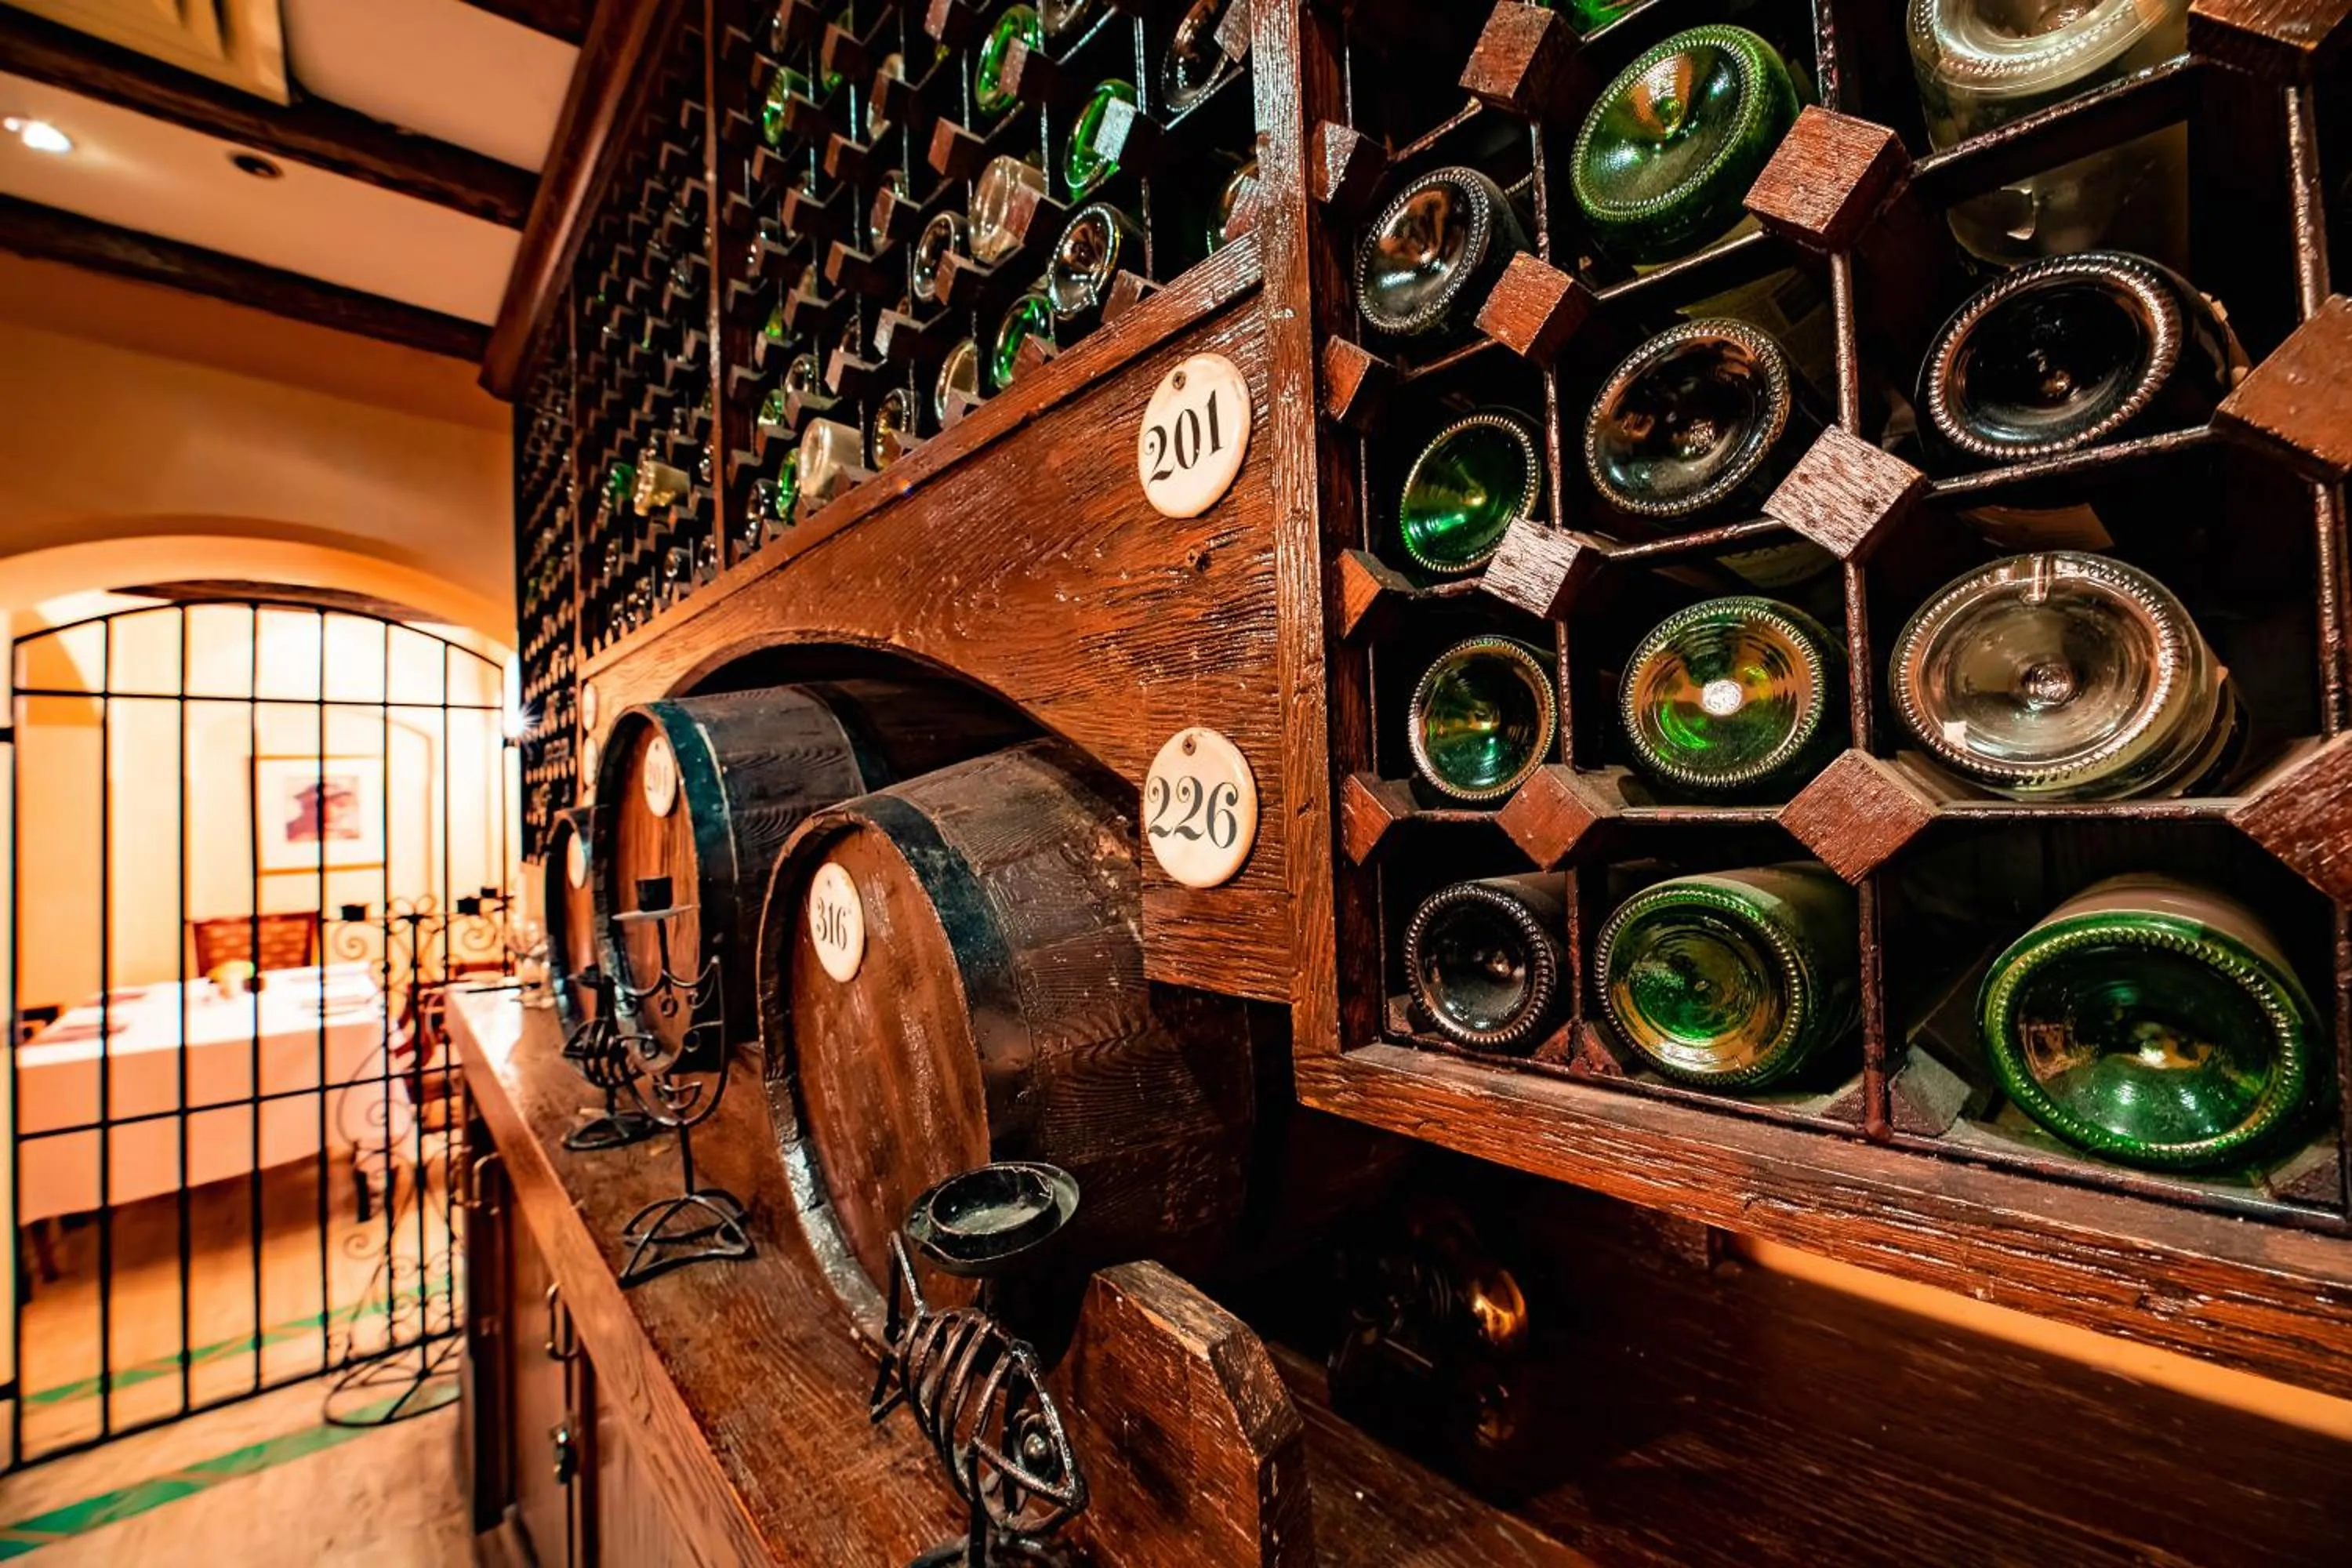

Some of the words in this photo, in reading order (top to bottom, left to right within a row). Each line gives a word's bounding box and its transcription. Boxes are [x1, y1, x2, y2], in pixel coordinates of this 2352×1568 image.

[1144, 389, 1224, 488] 201
[1147, 775, 1239, 849] 226
[816, 897, 848, 951] 316
